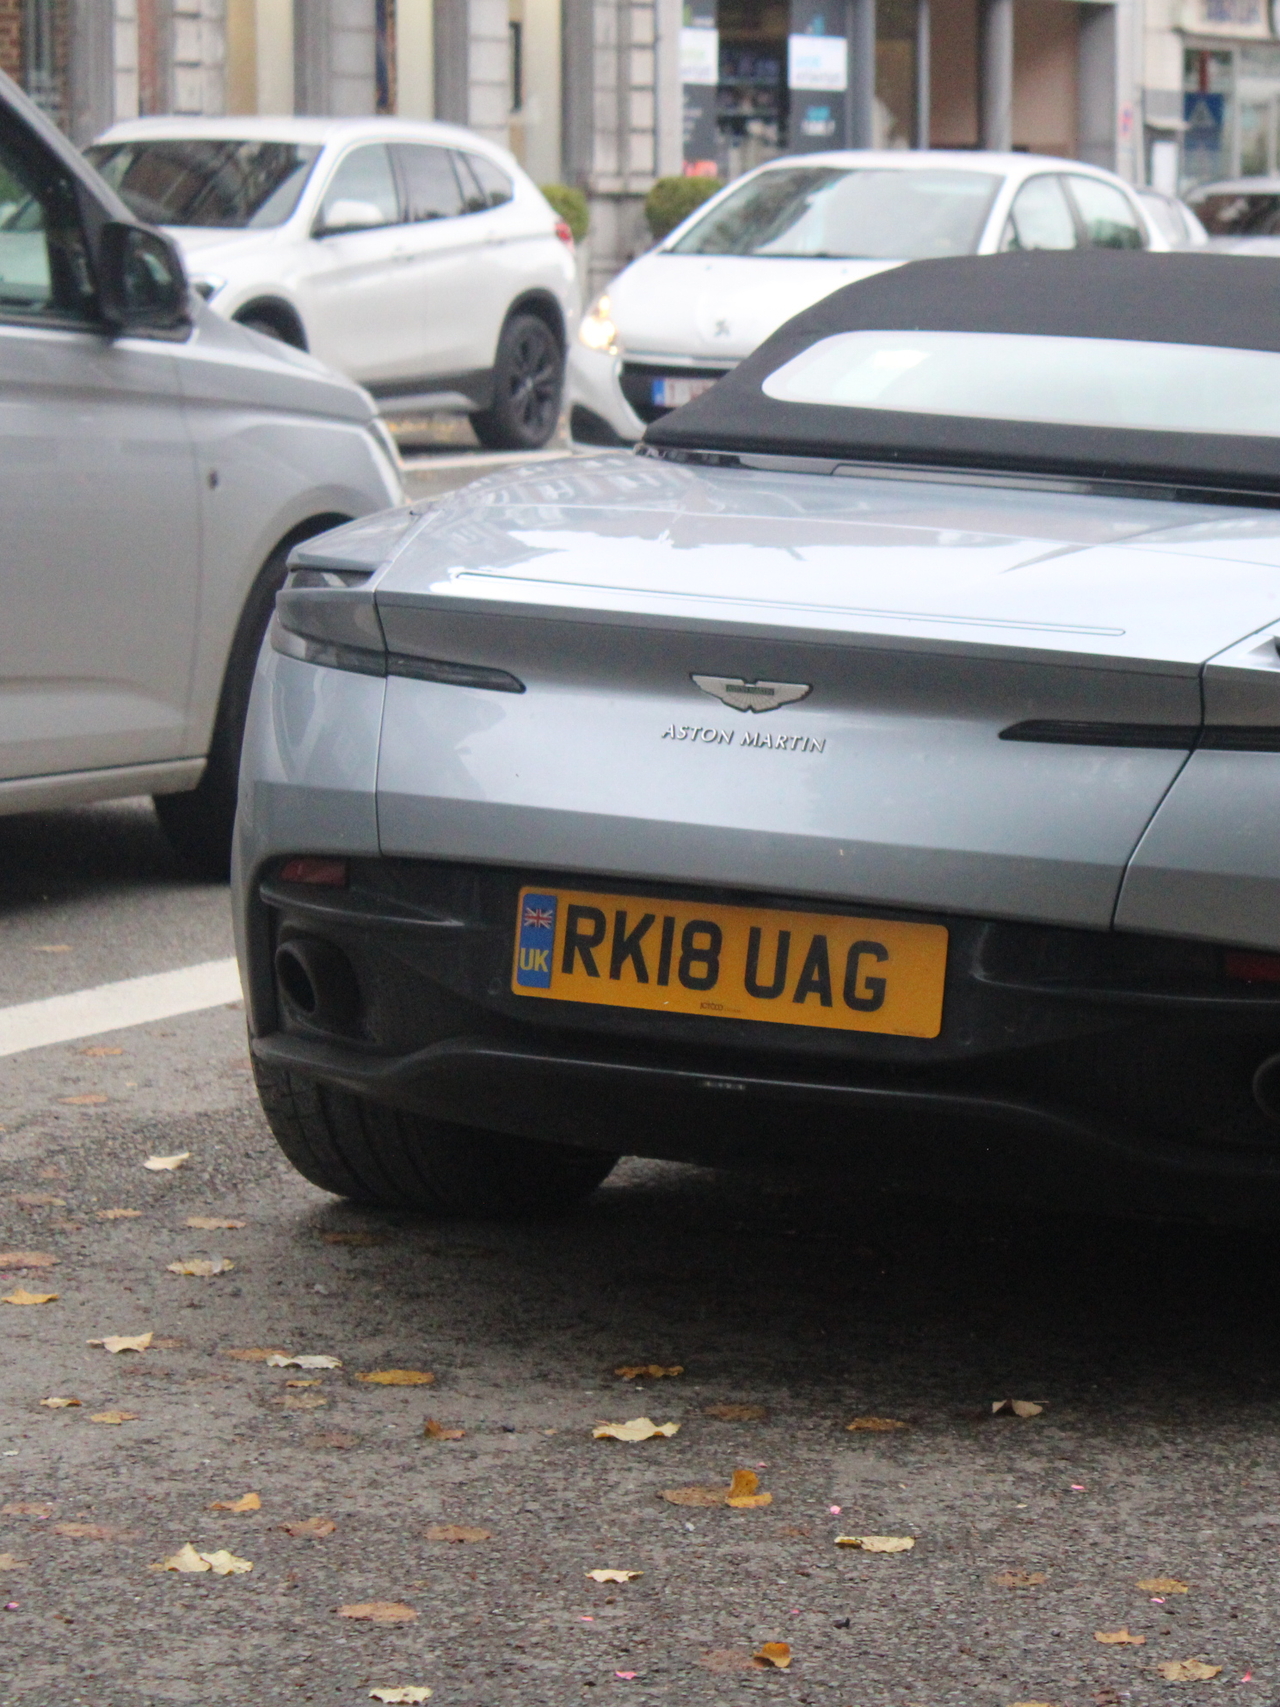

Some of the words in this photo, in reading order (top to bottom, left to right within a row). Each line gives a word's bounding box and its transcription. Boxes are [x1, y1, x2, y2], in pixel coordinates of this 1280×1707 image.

[661, 723, 735, 746] ASTON
[740, 731, 827, 754] MARTIN
[519, 947, 550, 973] UK
[561, 903, 723, 991] RK18
[743, 926, 890, 1013] UAG
